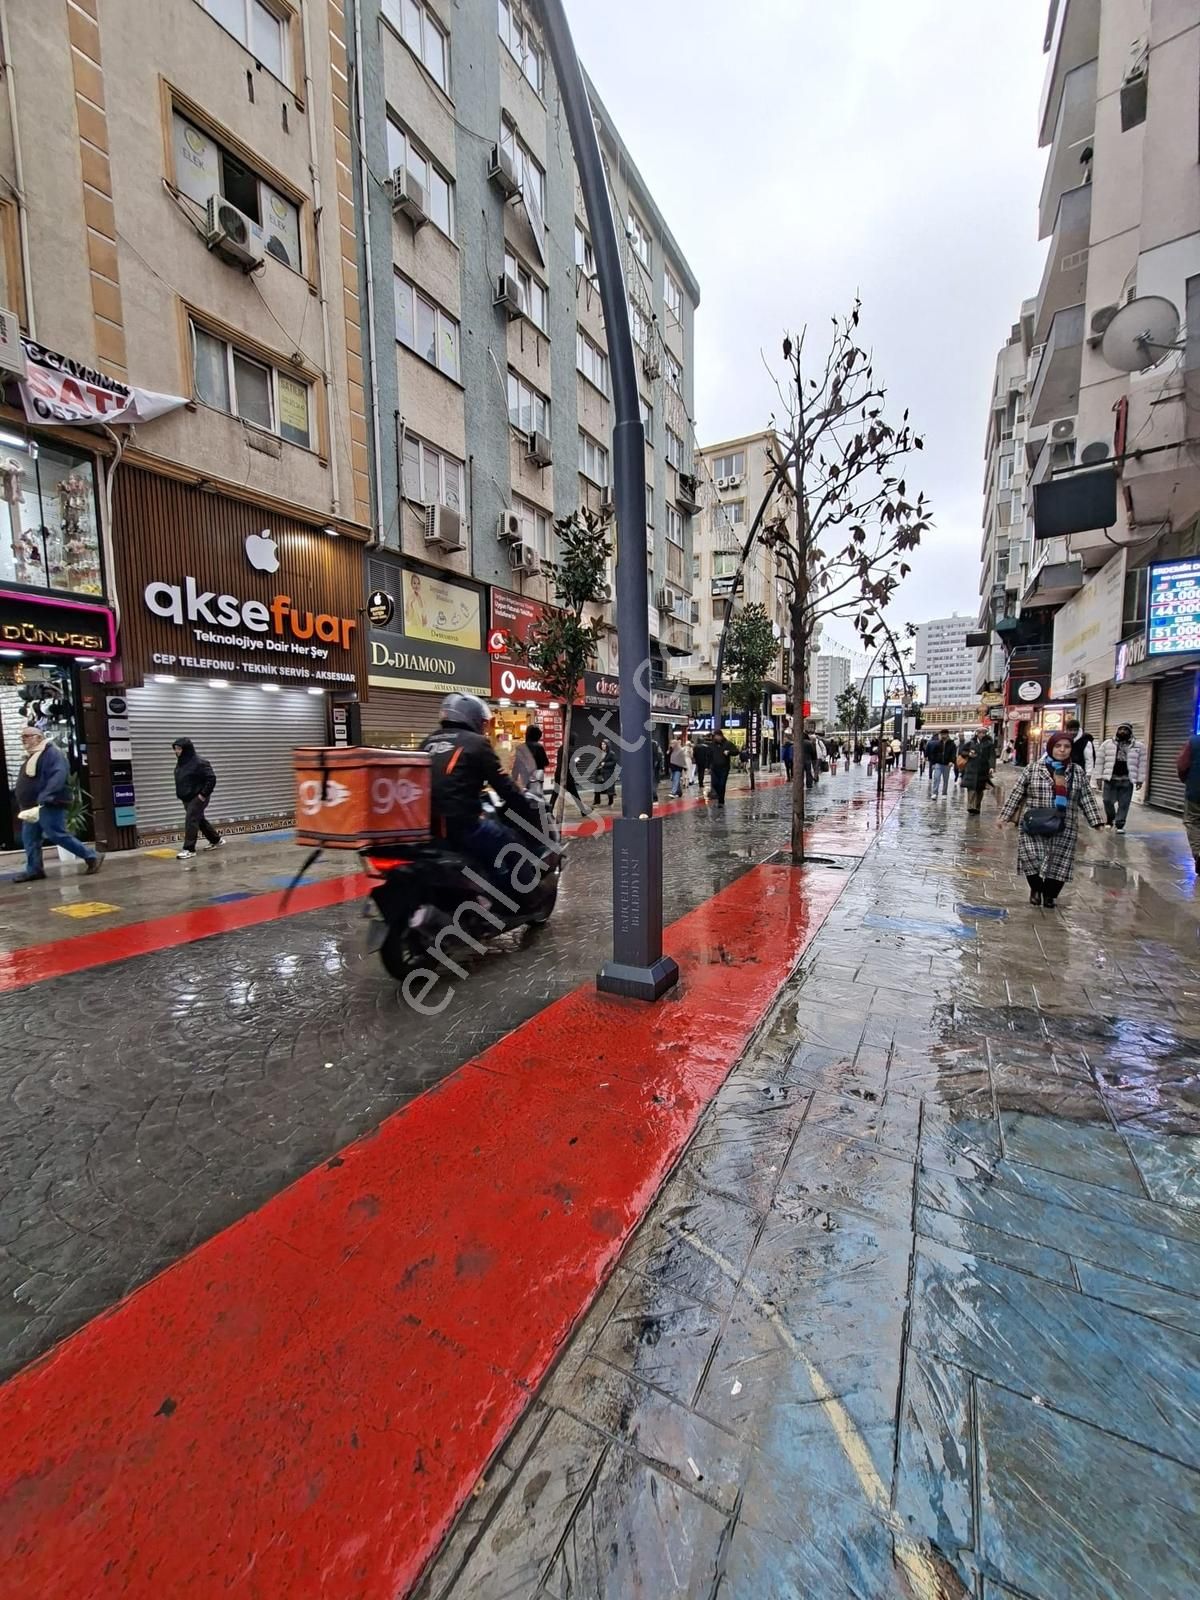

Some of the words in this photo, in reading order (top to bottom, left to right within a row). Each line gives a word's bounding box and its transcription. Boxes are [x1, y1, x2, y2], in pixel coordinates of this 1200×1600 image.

[144, 575, 357, 650] aksefuar
[3, 623, 103, 649] DÜNYASI
[194, 630, 264, 650] Teknolojiye
[266, 639, 290, 652] Dair
[291, 643, 309, 655] Her
[310, 646, 329, 660] Şey
[153, 653, 176, 665] CEP
[179, 655, 235, 671] TELEFONU
[242, 661, 278, 675] TEKNİK
[279, 664, 310, 678] SERVİS
[316, 671, 356, 682] AKSESUAR
[394, 652, 456, 675] DIAMOND
